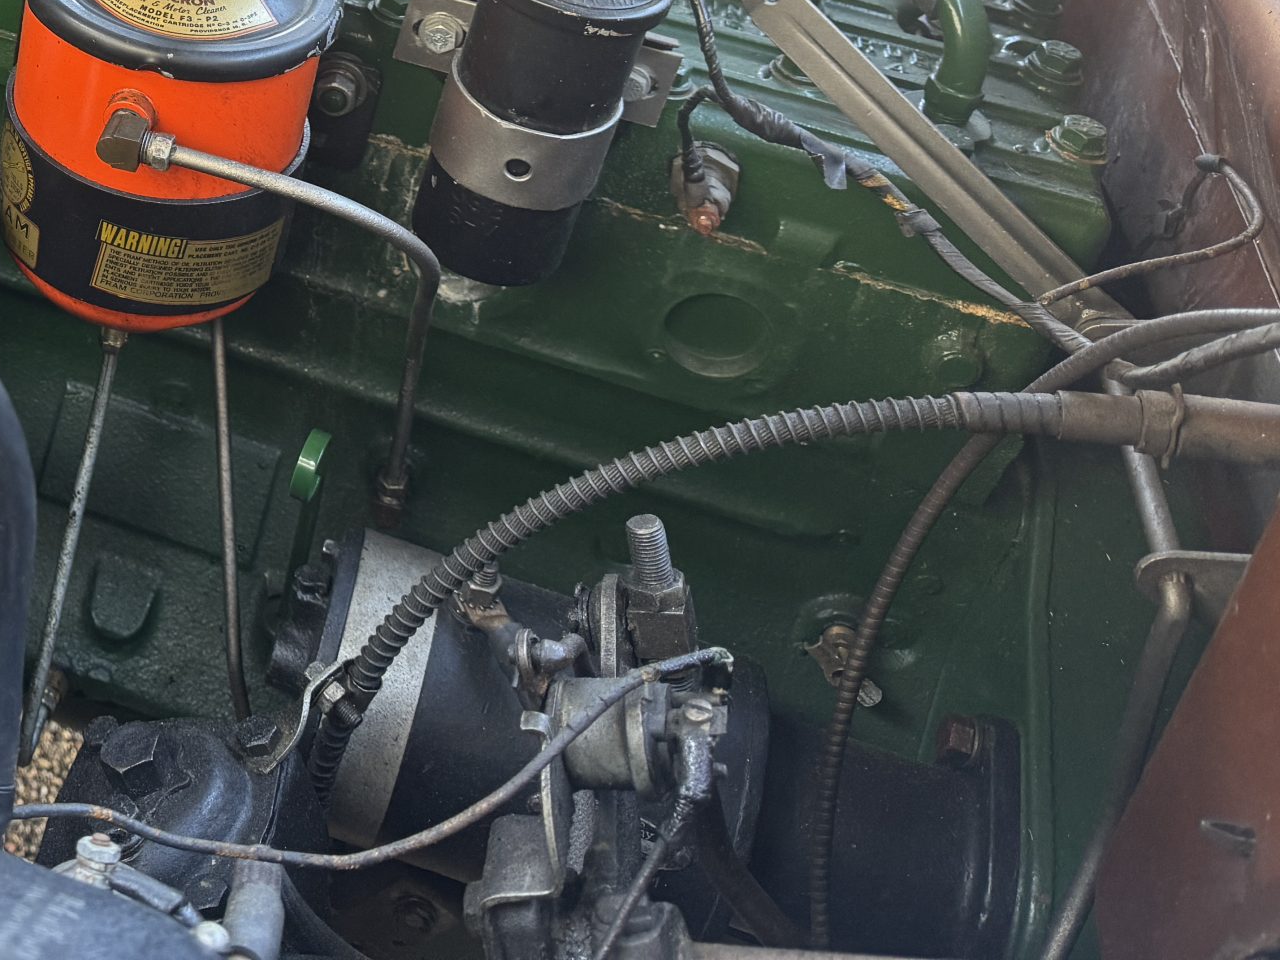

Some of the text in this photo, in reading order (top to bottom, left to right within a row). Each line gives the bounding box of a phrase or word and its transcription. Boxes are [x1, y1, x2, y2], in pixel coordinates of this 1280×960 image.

[140, 4, 175, 20] MODEL
[163, 3, 190, 14] Motor
[196, 6, 227, 15] Cleaner
[122, 9, 165, 28] CORPORATION
[163, 19, 204, 28] CARTRIDGE
[4, 204, 29, 240] AM
[100, 221, 187, 259] WARNING!
[108, 254, 139, 266] SPECIALLY
[142, 263, 173, 272] DESIGNED
[103, 269, 138, 282] PLACEMENT
[100, 279, 127, 291] FRAM
[131, 287, 194, 299] CORPORATION
